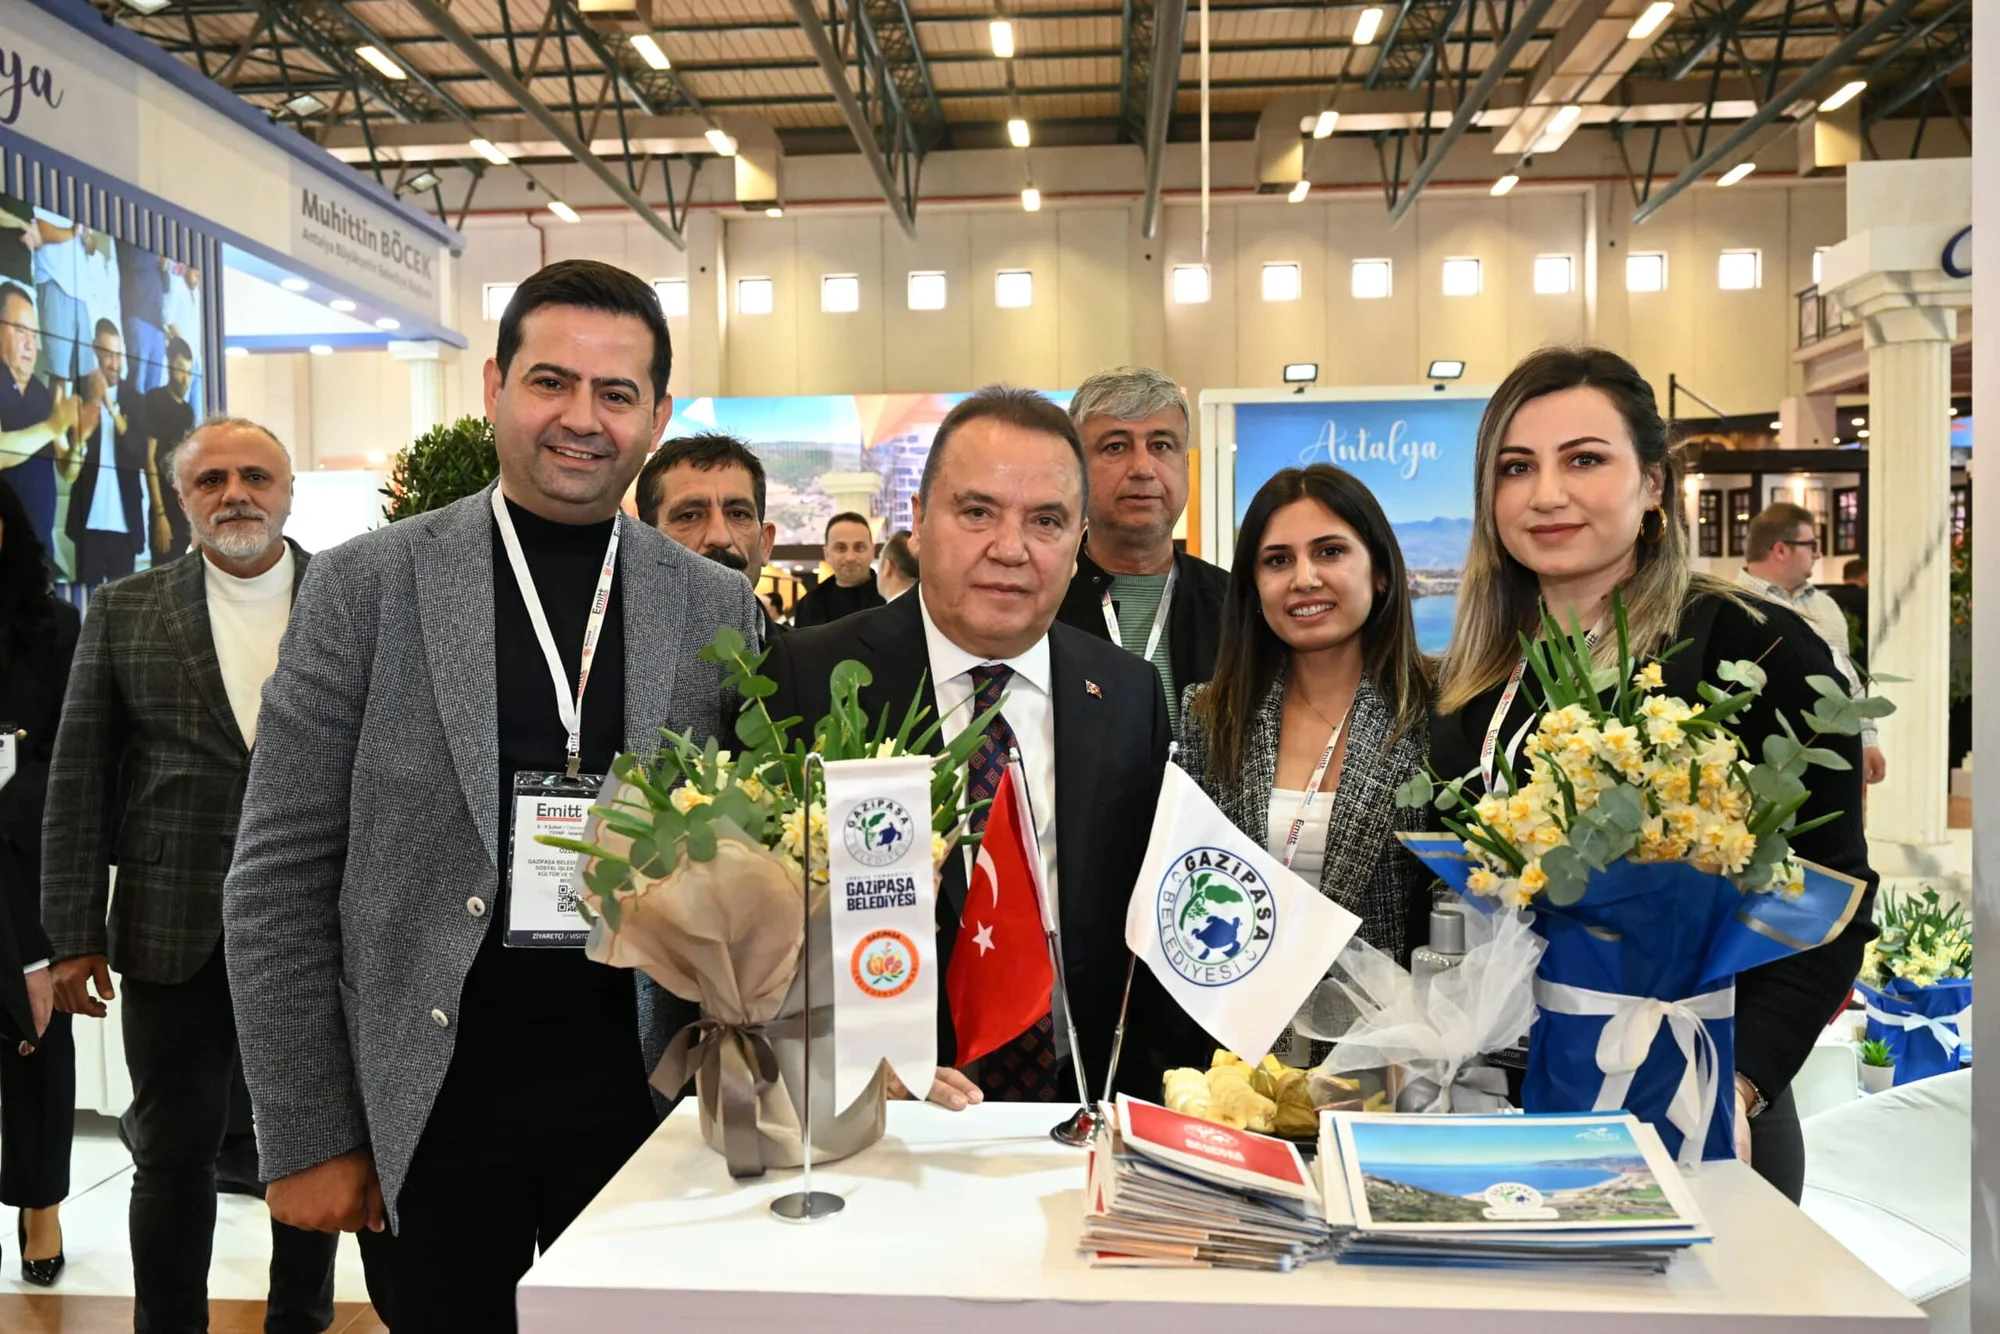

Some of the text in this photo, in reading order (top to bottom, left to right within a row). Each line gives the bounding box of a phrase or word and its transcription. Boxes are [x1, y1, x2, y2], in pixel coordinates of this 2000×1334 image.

[302, 187, 432, 280] Muhittin BÖCEK
[1299, 419, 1443, 481] Antalya
[592, 587, 607, 615] Emitt
[1319, 745, 1334, 770] Emitt
[536, 802, 583, 818] Emitt
[1289, 818, 1305, 846] Emitt
[847, 893, 916, 911] BELEDİYESİ
[532, 932, 564, 940] ZİYARETÇİ
[569, 932, 589, 940] VISITO
